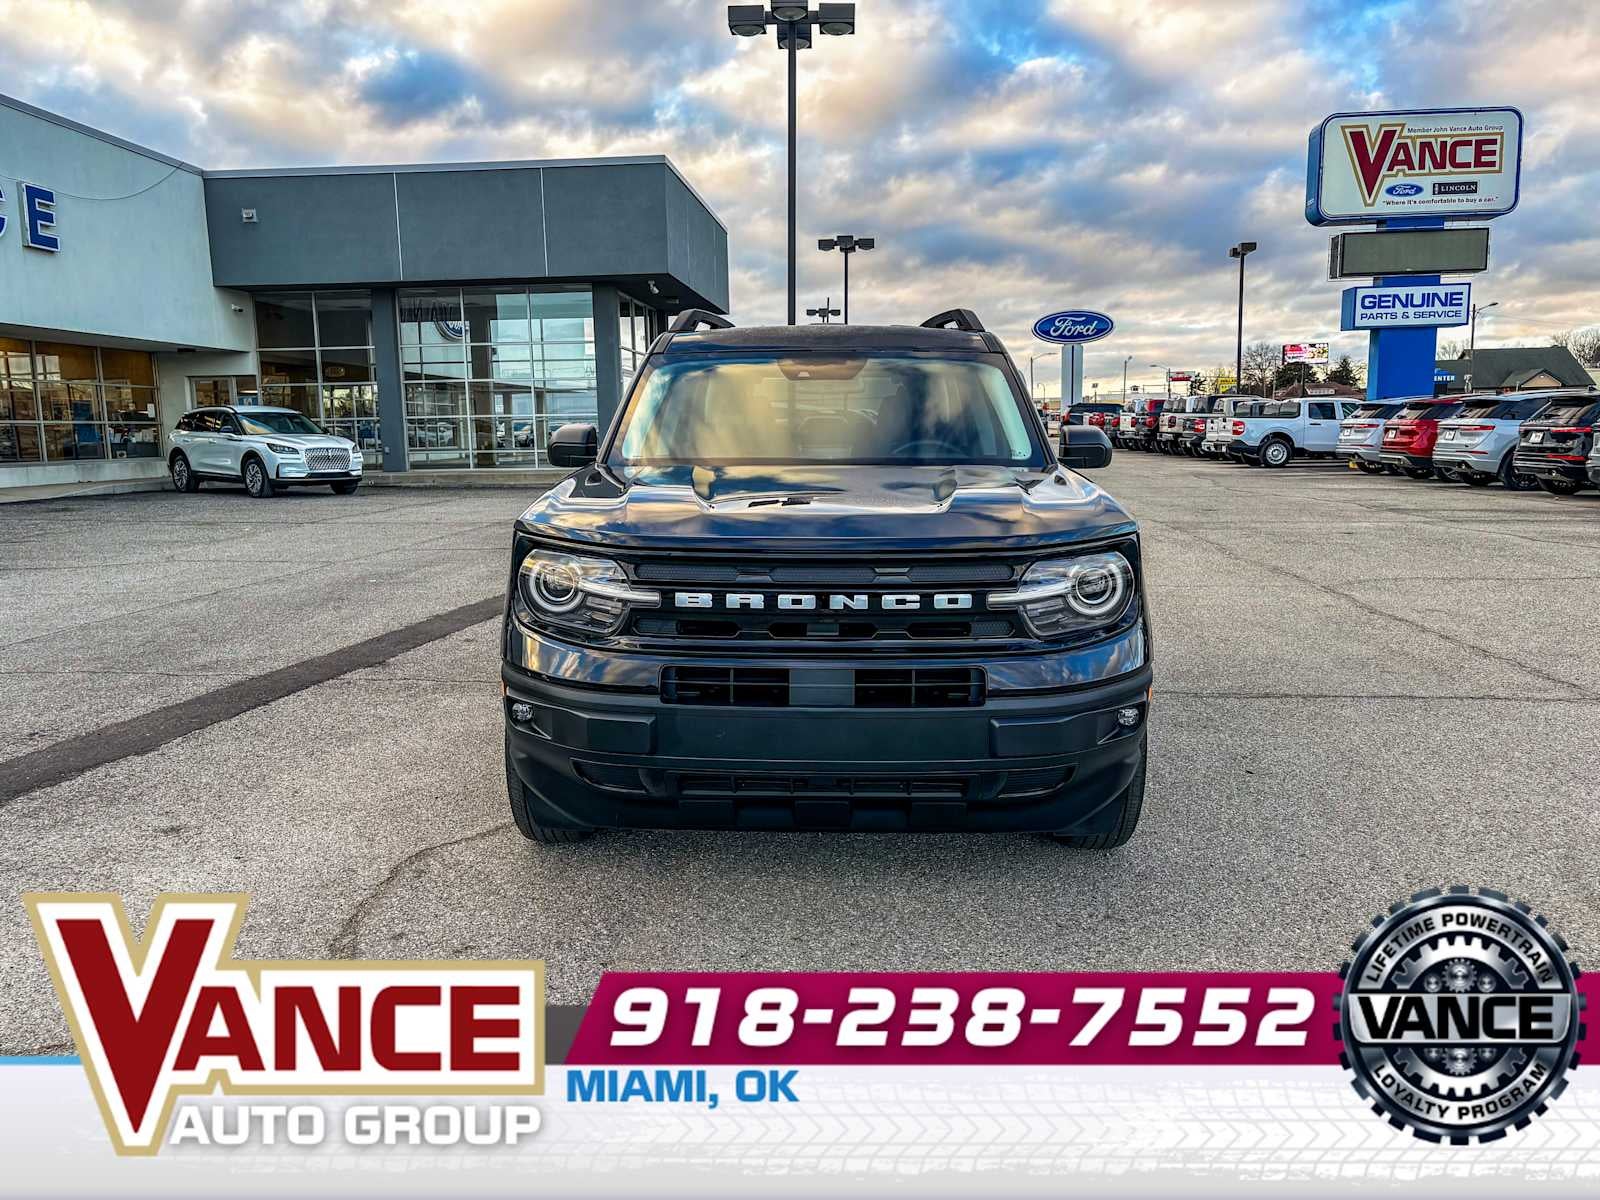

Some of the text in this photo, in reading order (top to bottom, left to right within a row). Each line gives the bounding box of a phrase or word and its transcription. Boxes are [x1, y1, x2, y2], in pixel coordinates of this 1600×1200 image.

[1348, 128, 1499, 200] VANCE
[1392, 185, 1417, 195] Ford
[1441, 184, 1476, 192] LINCOLN
[1361, 291, 1464, 310] GENUINE
[1360, 310, 1462, 321] PARTS & SERVICE
[1050, 316, 1098, 337] Ford
[674, 591, 973, 610] BRONCO
